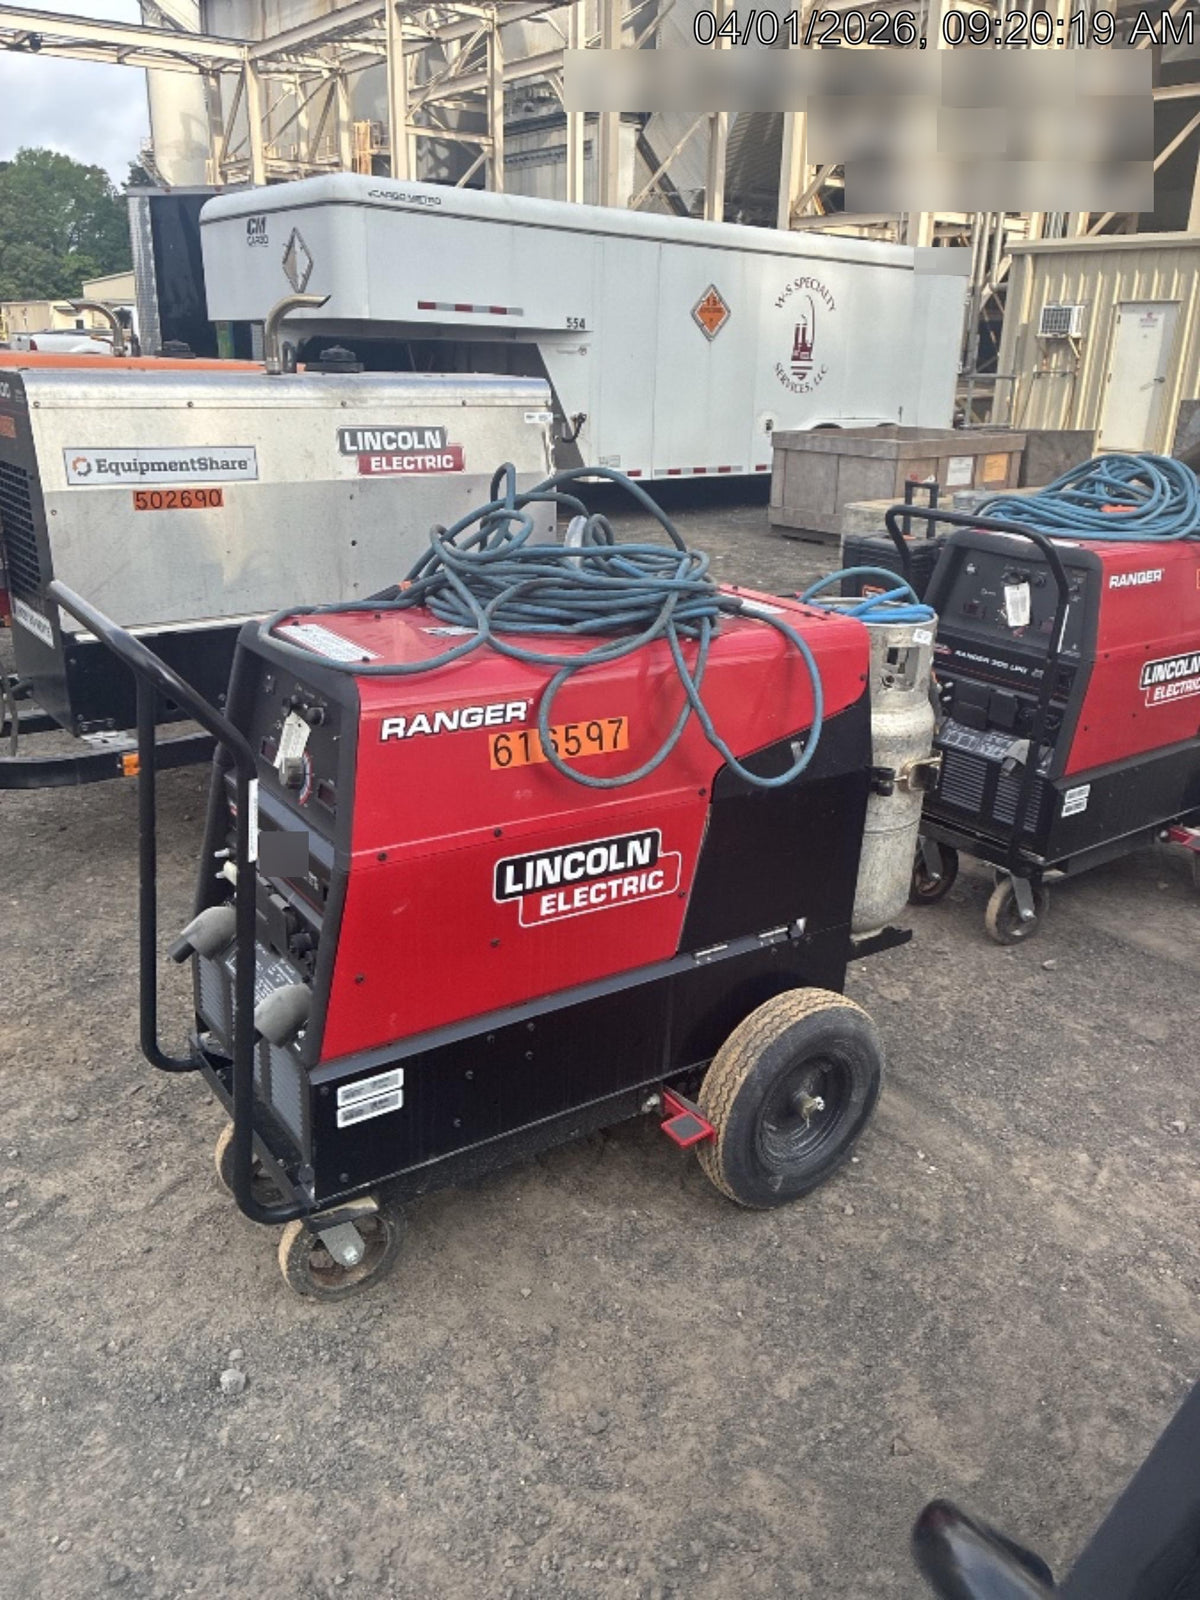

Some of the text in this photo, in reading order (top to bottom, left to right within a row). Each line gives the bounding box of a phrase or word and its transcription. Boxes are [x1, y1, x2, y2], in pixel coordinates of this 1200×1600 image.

[246, 216, 267, 235] CM
[793, 276, 837, 312] SPECIALTY
[566, 316, 587, 330] 554
[344, 428, 443, 451] LINCOLN
[95, 457, 249, 475] EquipmentShare
[370, 452, 454, 472] ELECTRIC
[135, 488, 223, 511] 502690
[1109, 568, 1163, 589] RANGER
[1143, 655, 1200, 686] LINCOLN
[1153, 676, 1200, 701] ELECTRIC
[380, 700, 529, 741] RANGER
[504, 837, 652, 894] LINCOLN
[539, 870, 664, 917] ELECTRIC
